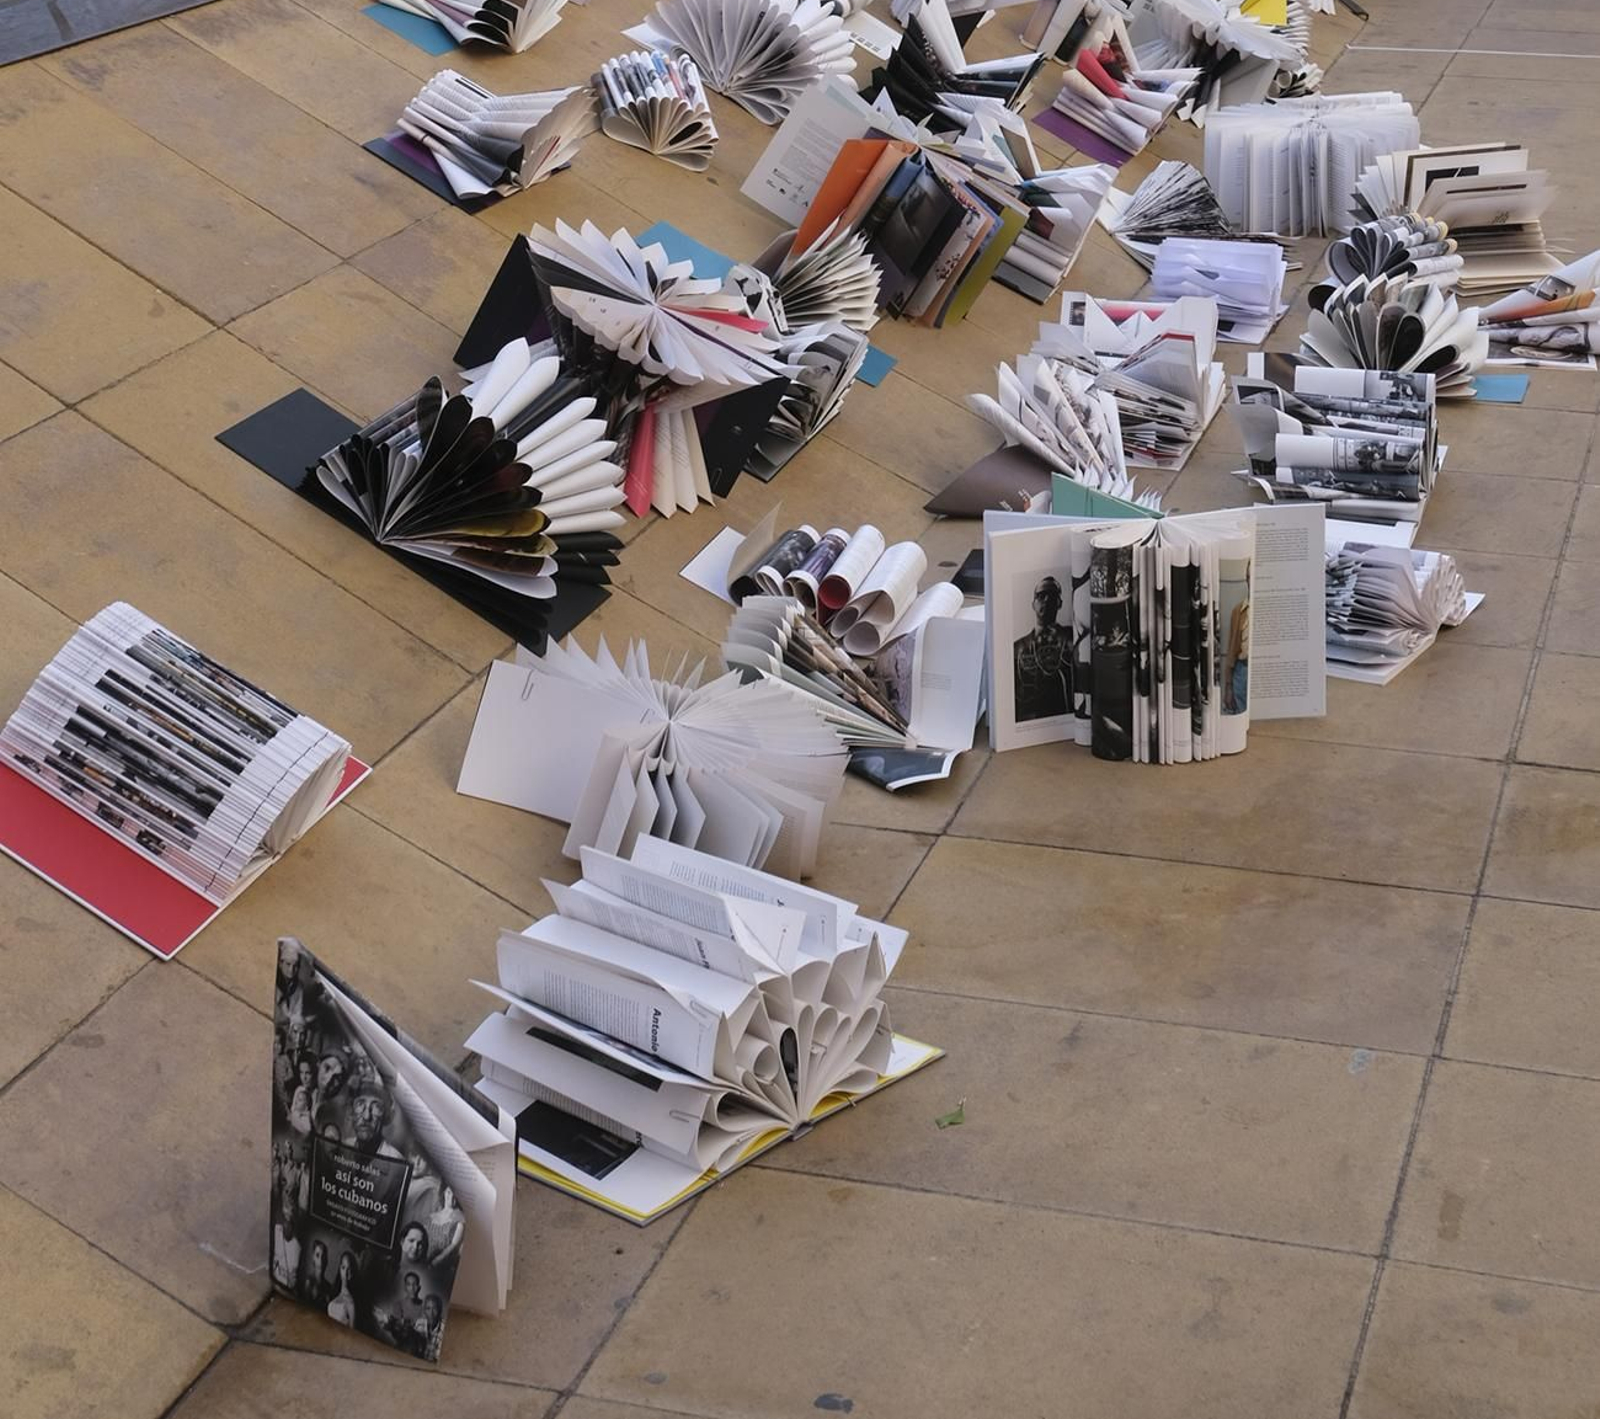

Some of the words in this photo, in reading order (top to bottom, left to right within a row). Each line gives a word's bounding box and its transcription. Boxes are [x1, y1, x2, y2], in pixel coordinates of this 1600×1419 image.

[651, 1008, 661, 1052] Antonio
[321, 1176, 337, 1195] los
[338, 1188, 388, 1214] cubanos
[335, 1170, 352, 1184] así
[353, 1177, 375, 1192] son
